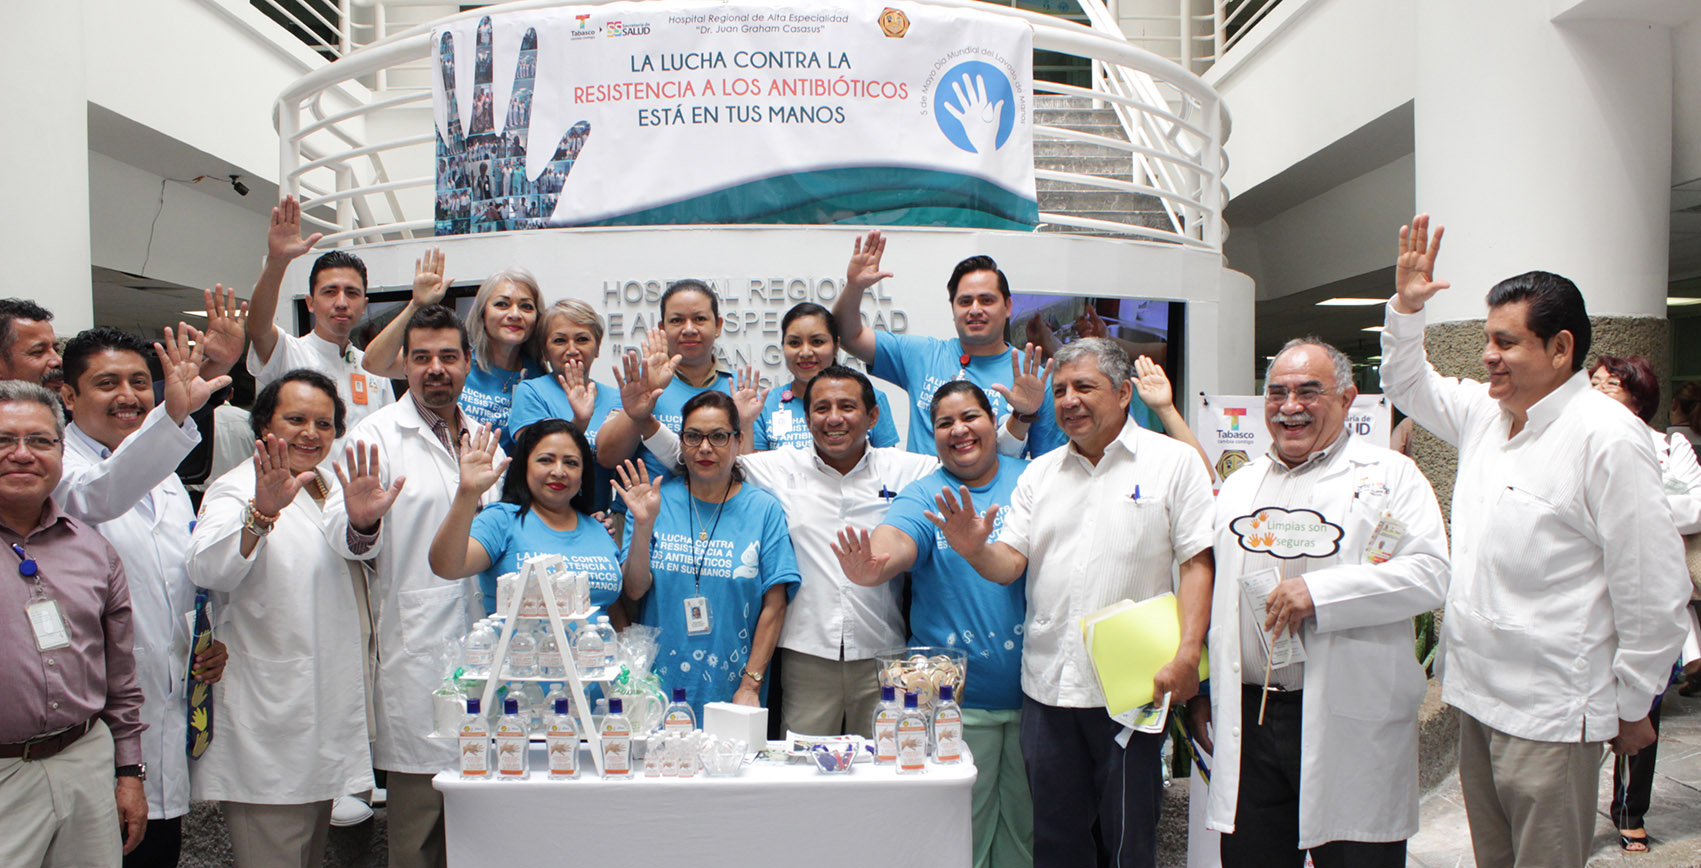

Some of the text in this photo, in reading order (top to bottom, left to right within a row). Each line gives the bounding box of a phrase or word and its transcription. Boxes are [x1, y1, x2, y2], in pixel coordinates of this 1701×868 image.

[668, 14, 849, 25] Hospital Regional de Alta Especialidad
[623, 27, 651, 37] SALUD
[715, 25, 738, 33] Juan
[741, 25, 780, 33] Graham
[783, 25, 825, 34] Casasus"
[946, 46, 980, 60] Mundial
[981, 48, 994, 58] del
[631, 51, 851, 72] LA LUCHA CONTRA LA
[995, 53, 1017, 81] Lavado
[921, 69, 938, 93] Mayo
[1015, 81, 1022, 94] de
[573, 75, 909, 104] RESISTENCIA A LOS ANTIBIÓTICOS
[920, 93, 928, 108] de
[638, 104, 846, 127] ESTÁ EN TUS MANOS
[1216, 429, 1255, 439] Tabasco
[1267, 521, 1327, 533] Limpias son
[661, 533, 693, 544] LUCHA
[695, 539, 735, 550] CONTRA
[1276, 538, 1316, 549] seguras
[660, 541, 733, 558] RESISTENCIA A
[570, 555, 611, 563] CONTRA
[666, 562, 679, 572] EN
[680, 564, 698, 575] SUS
[699, 567, 732, 578] MANOS
